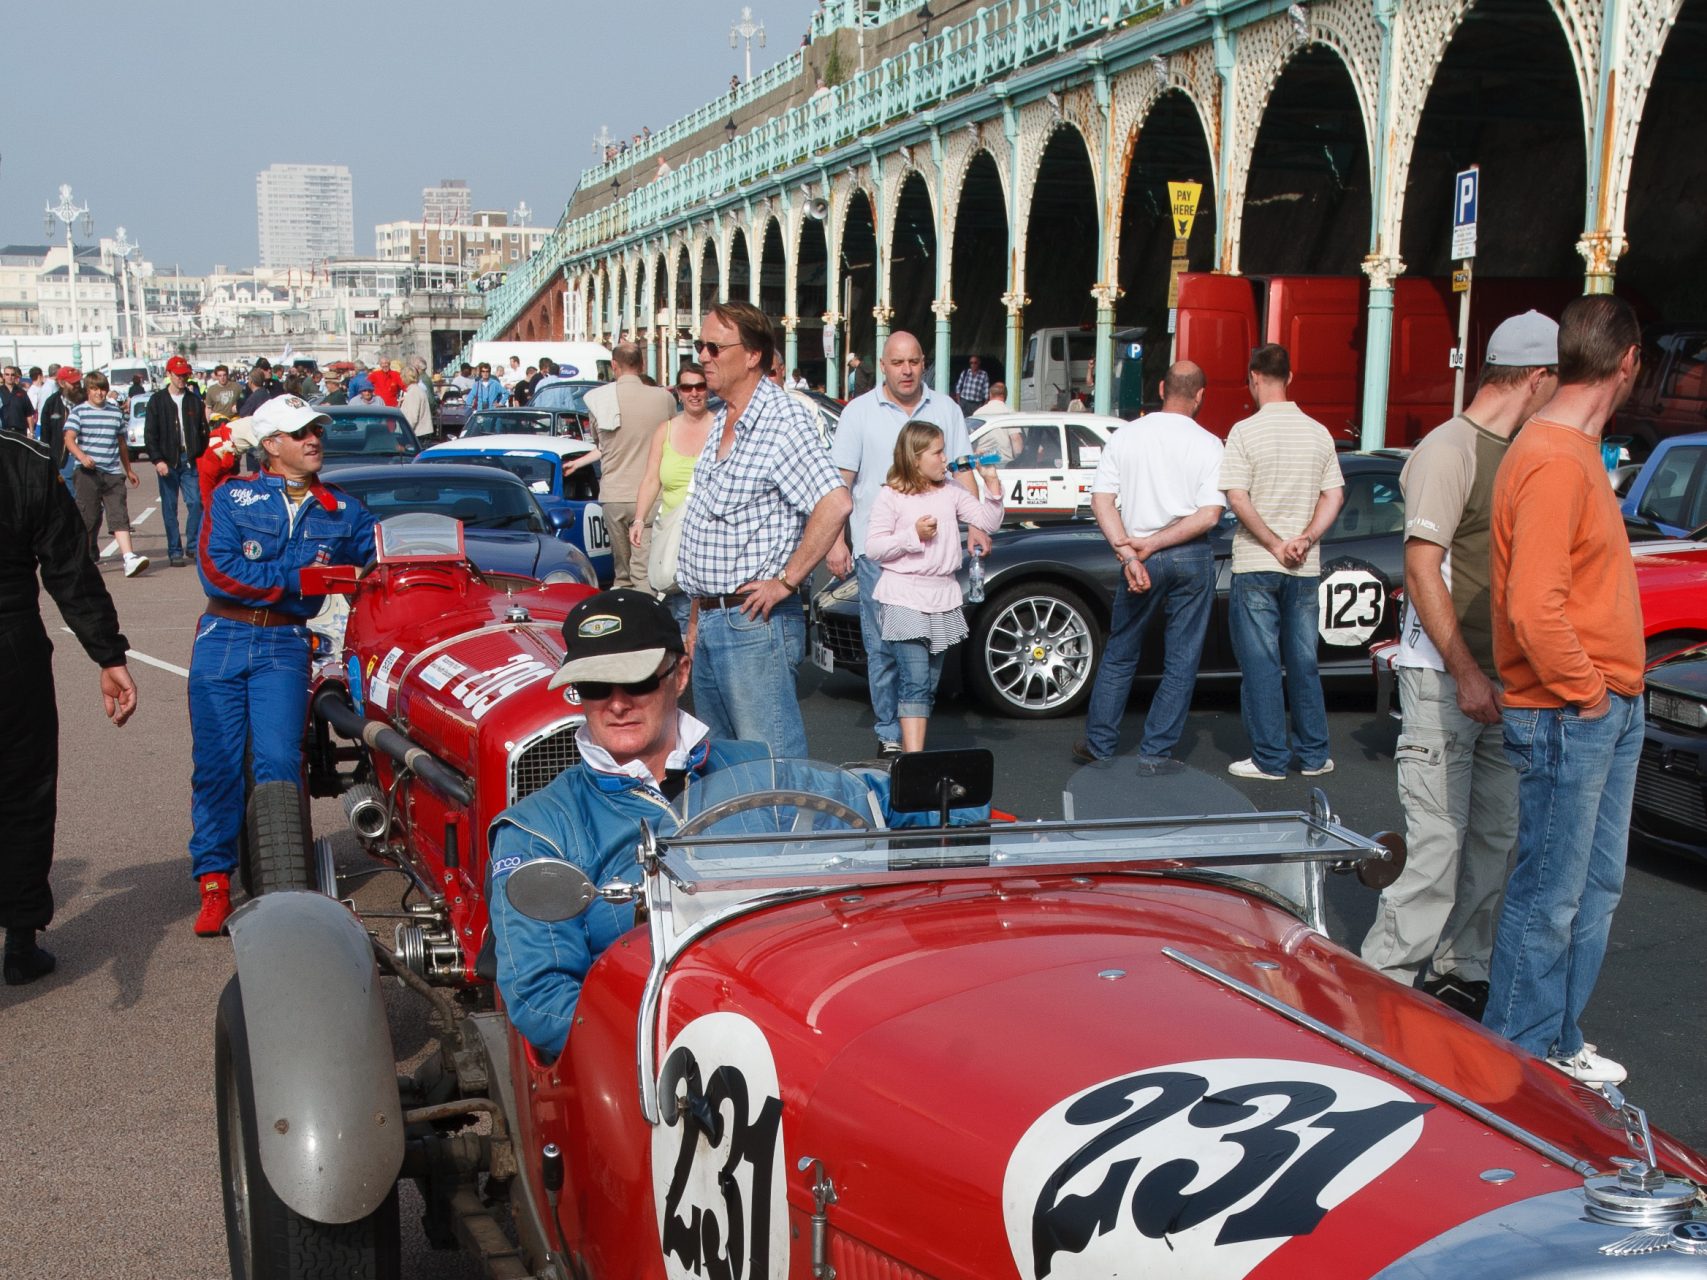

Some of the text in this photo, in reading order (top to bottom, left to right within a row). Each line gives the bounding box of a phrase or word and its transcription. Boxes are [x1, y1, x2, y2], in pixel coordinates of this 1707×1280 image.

[1176, 190, 1192, 201] PAY
[1459, 178, 1474, 222] P
[1173, 204, 1195, 216] HERE
[1131, 343, 1141, 358] P
[1010, 479, 1024, 505] 4
[1325, 581, 1382, 629] 123
[451, 653, 555, 720] 209
[493, 856, 521, 872] arco
